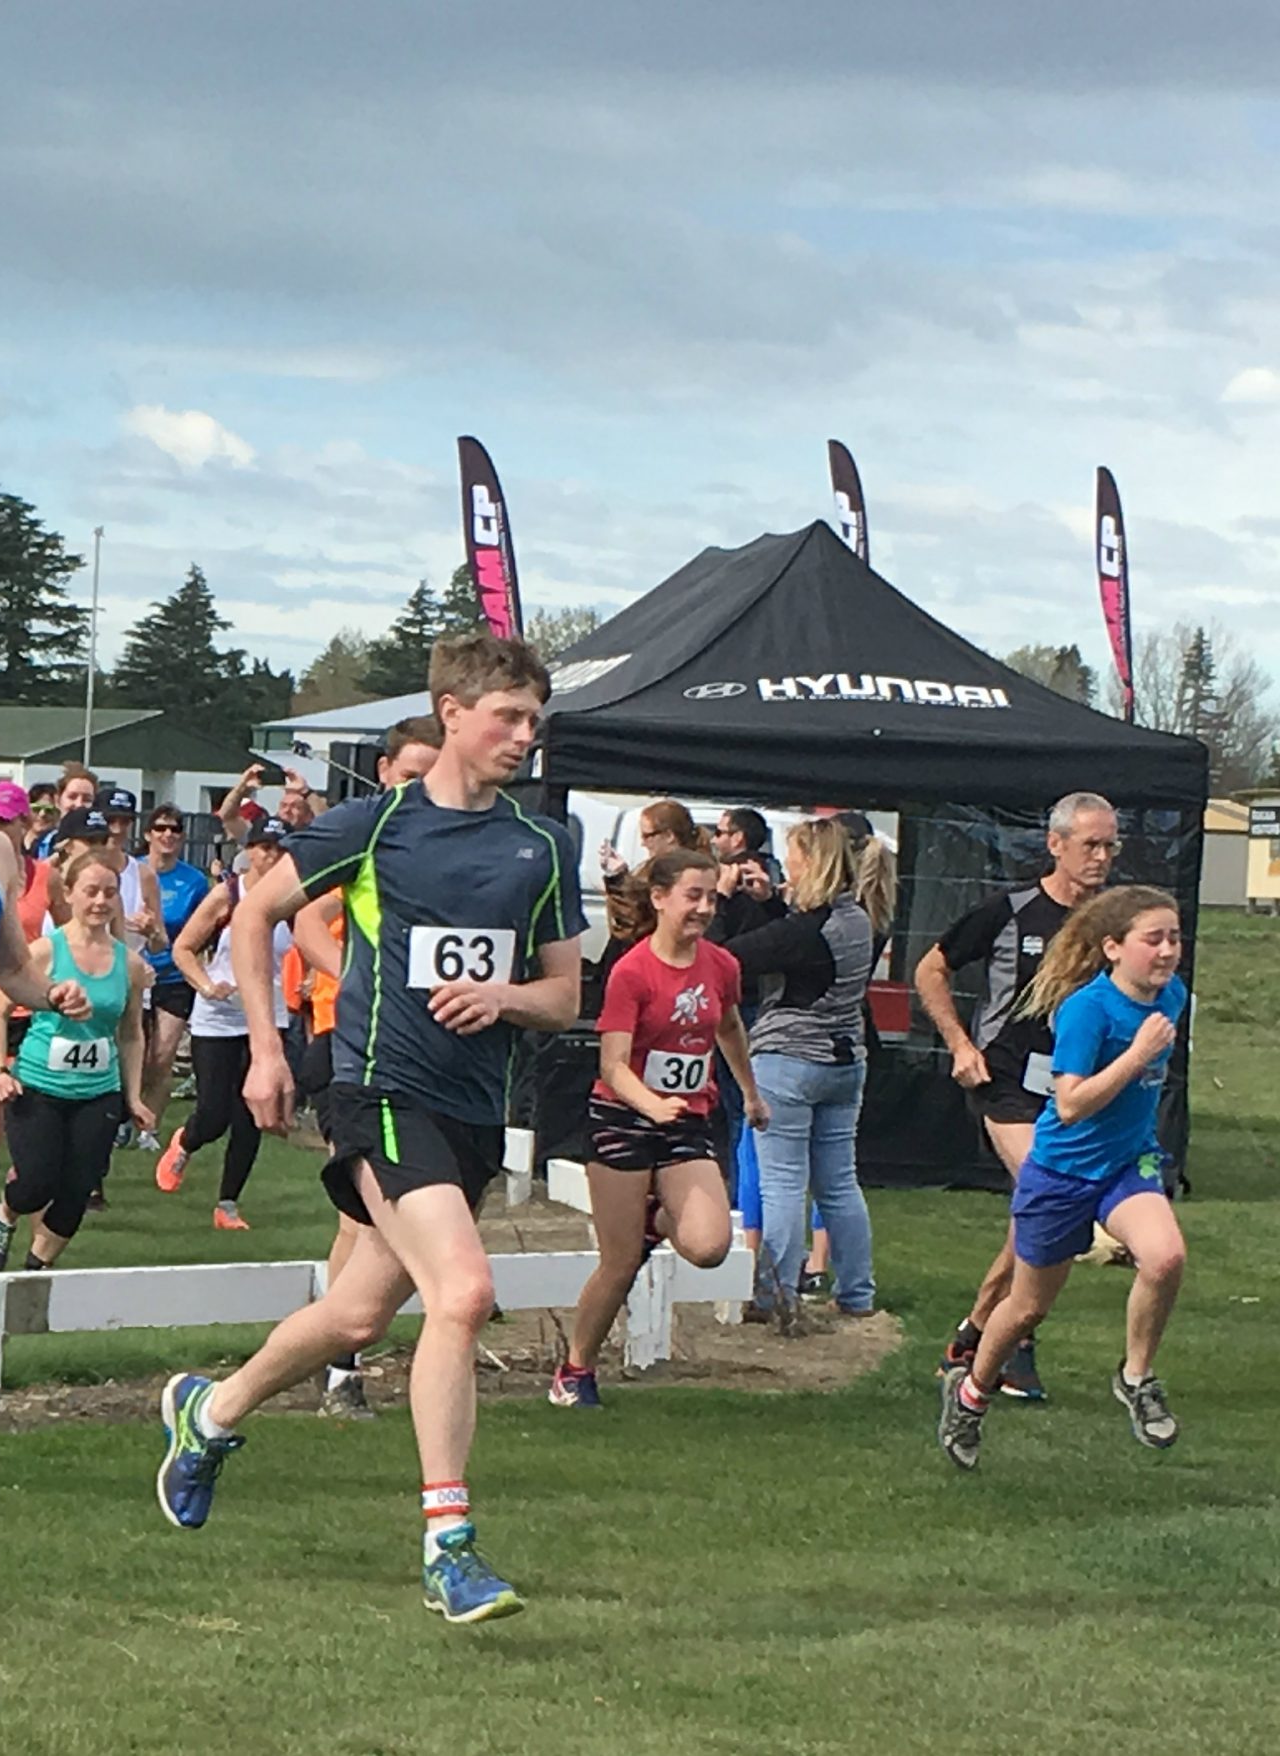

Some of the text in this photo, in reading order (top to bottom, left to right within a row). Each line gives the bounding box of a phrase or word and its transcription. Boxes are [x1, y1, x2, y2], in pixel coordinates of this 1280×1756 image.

[472, 484, 499, 546] CP
[1101, 515, 1120, 577] CP
[757, 673, 1009, 708] HYUNDAI
[435, 934, 495, 982] 63
[63, 1043, 99, 1068] 44
[661, 1057, 704, 1090] 30
